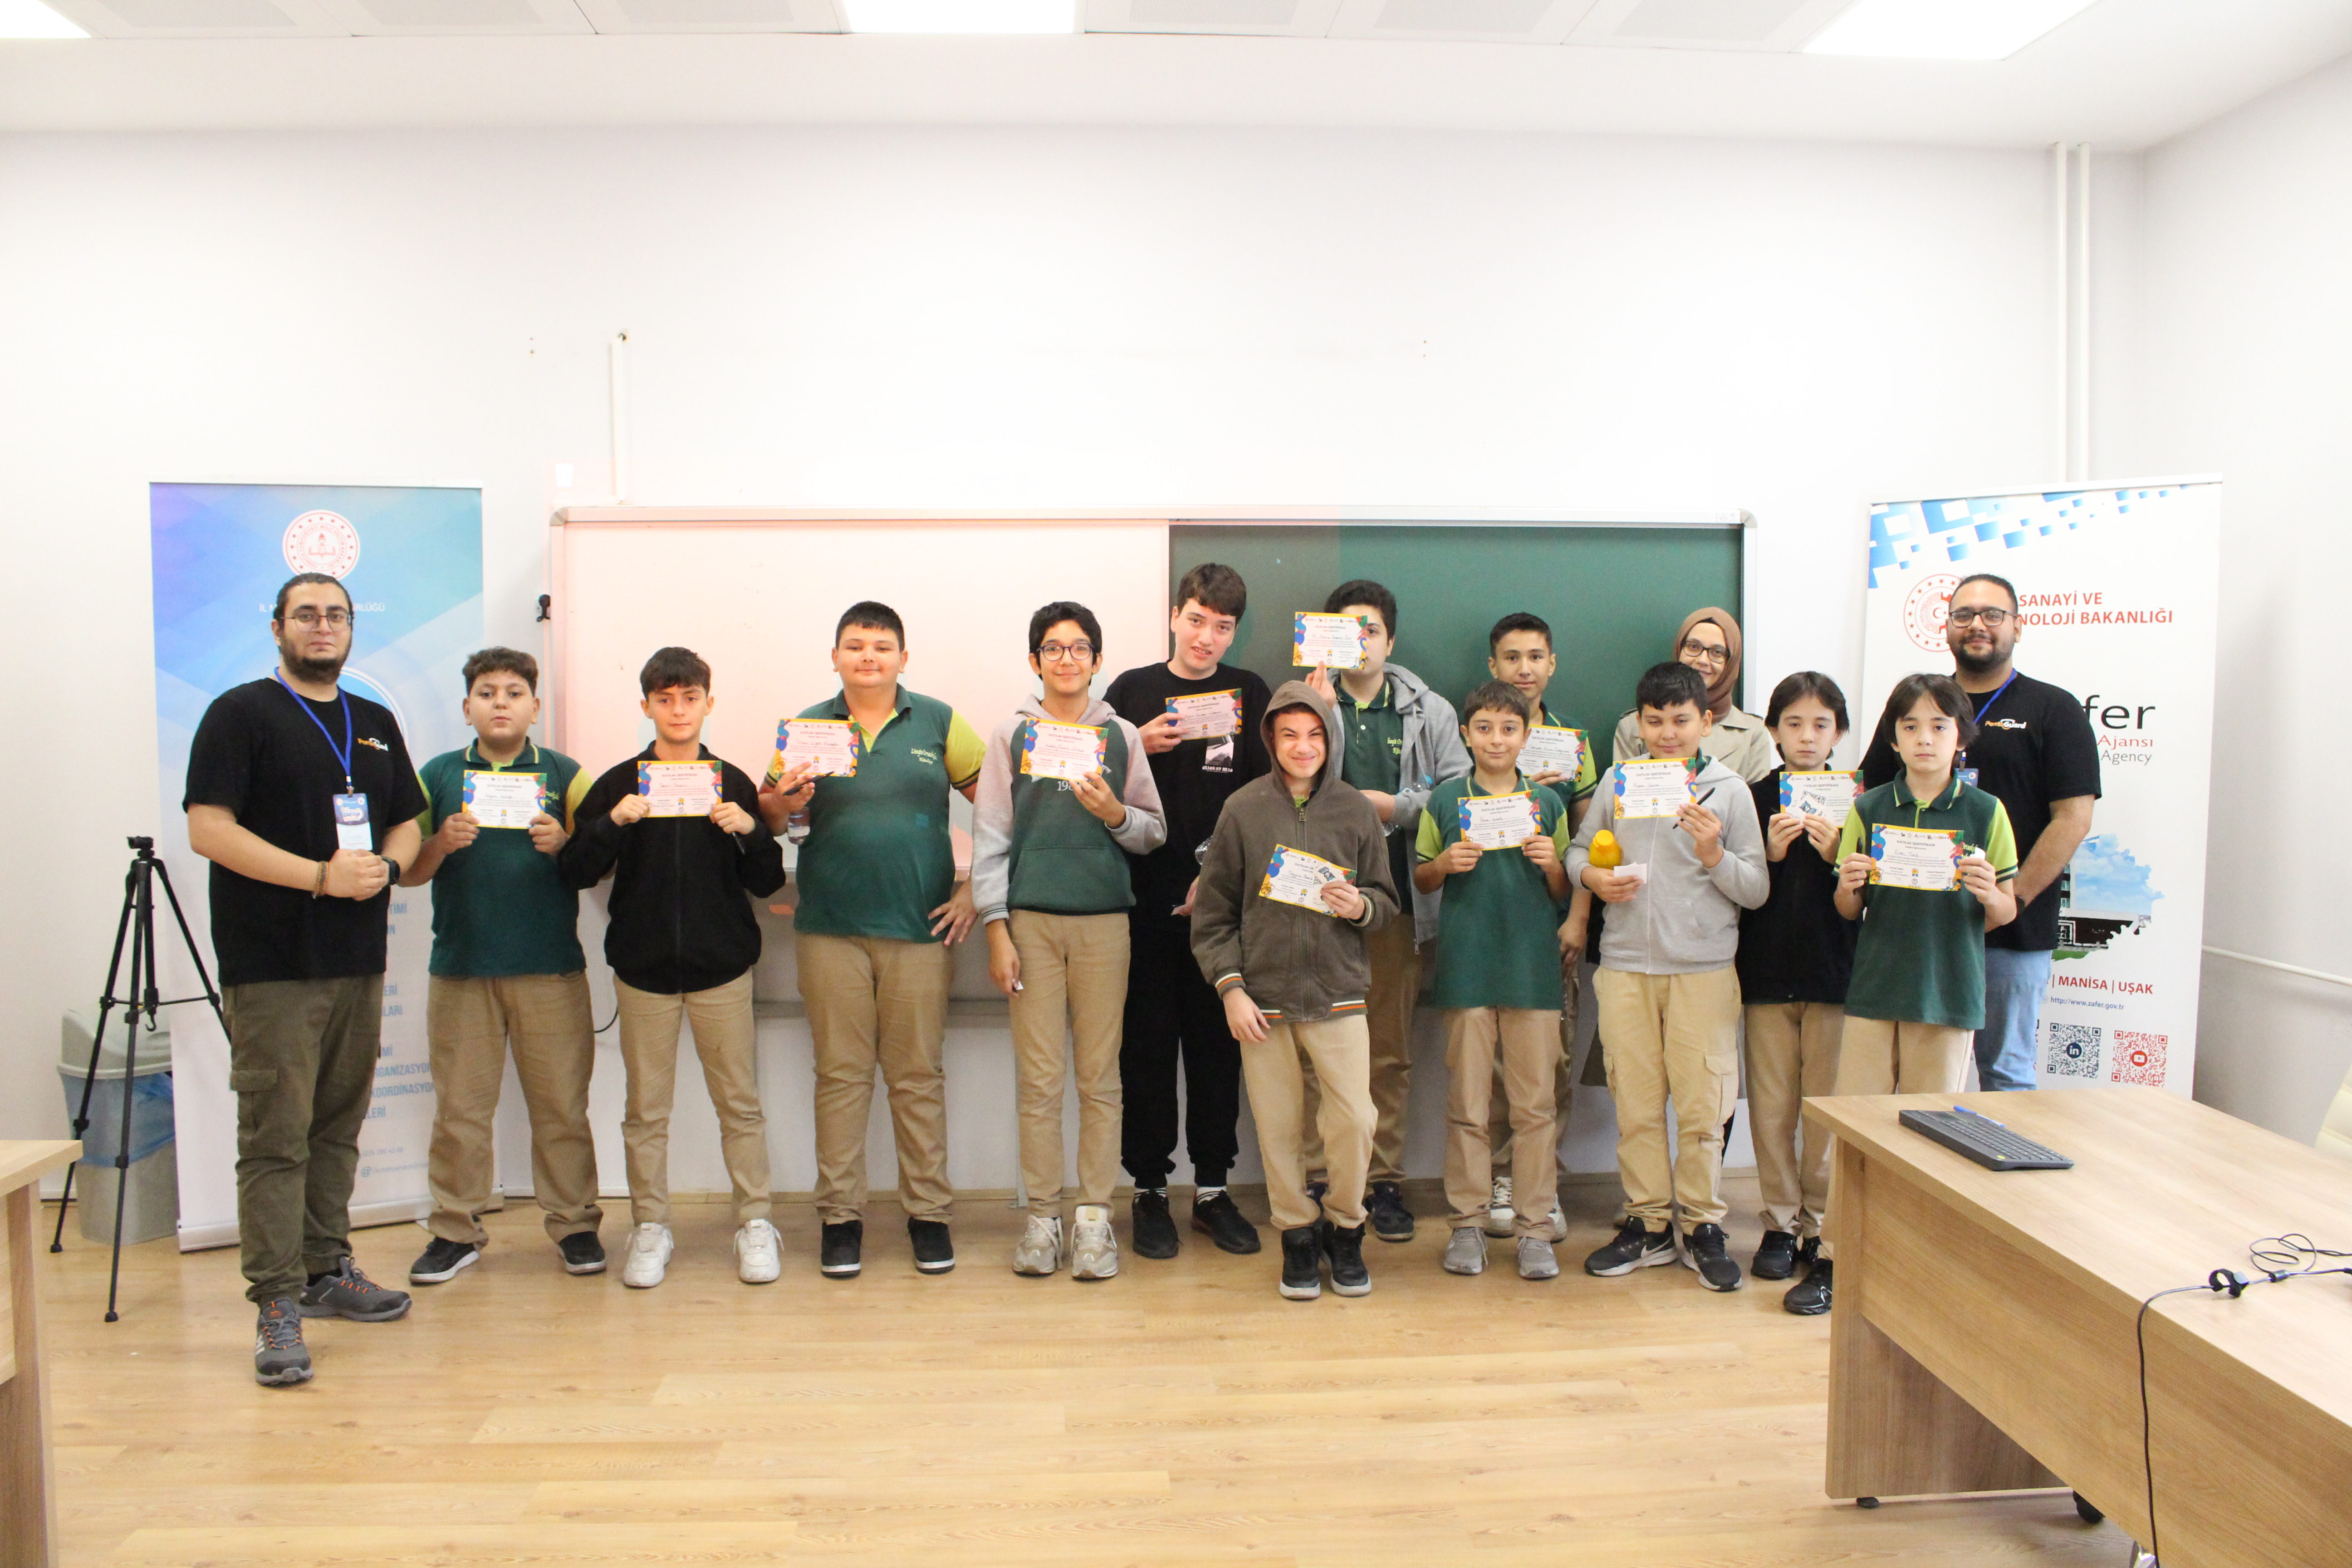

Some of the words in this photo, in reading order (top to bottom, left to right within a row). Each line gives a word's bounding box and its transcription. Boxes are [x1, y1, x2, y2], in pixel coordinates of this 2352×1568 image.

[2019, 590, 2078, 607] SANAYİ
[2082, 592, 2102, 605] VE
[259, 603, 267, 612] İL
[2018, 609, 2075, 626] NOLOJİ
[2081, 607, 2172, 624] BAKANLIĞI
[2081, 694, 2156, 730] fer
[2097, 734, 2153, 750] Ajansı
[2101, 750, 2152, 766] Agency
[2058, 975, 2108, 990] MANİSA
[2118, 981, 2154, 995] UŞAK
[2050, 996, 2125, 1010] http://www.zafer.gov.tr
